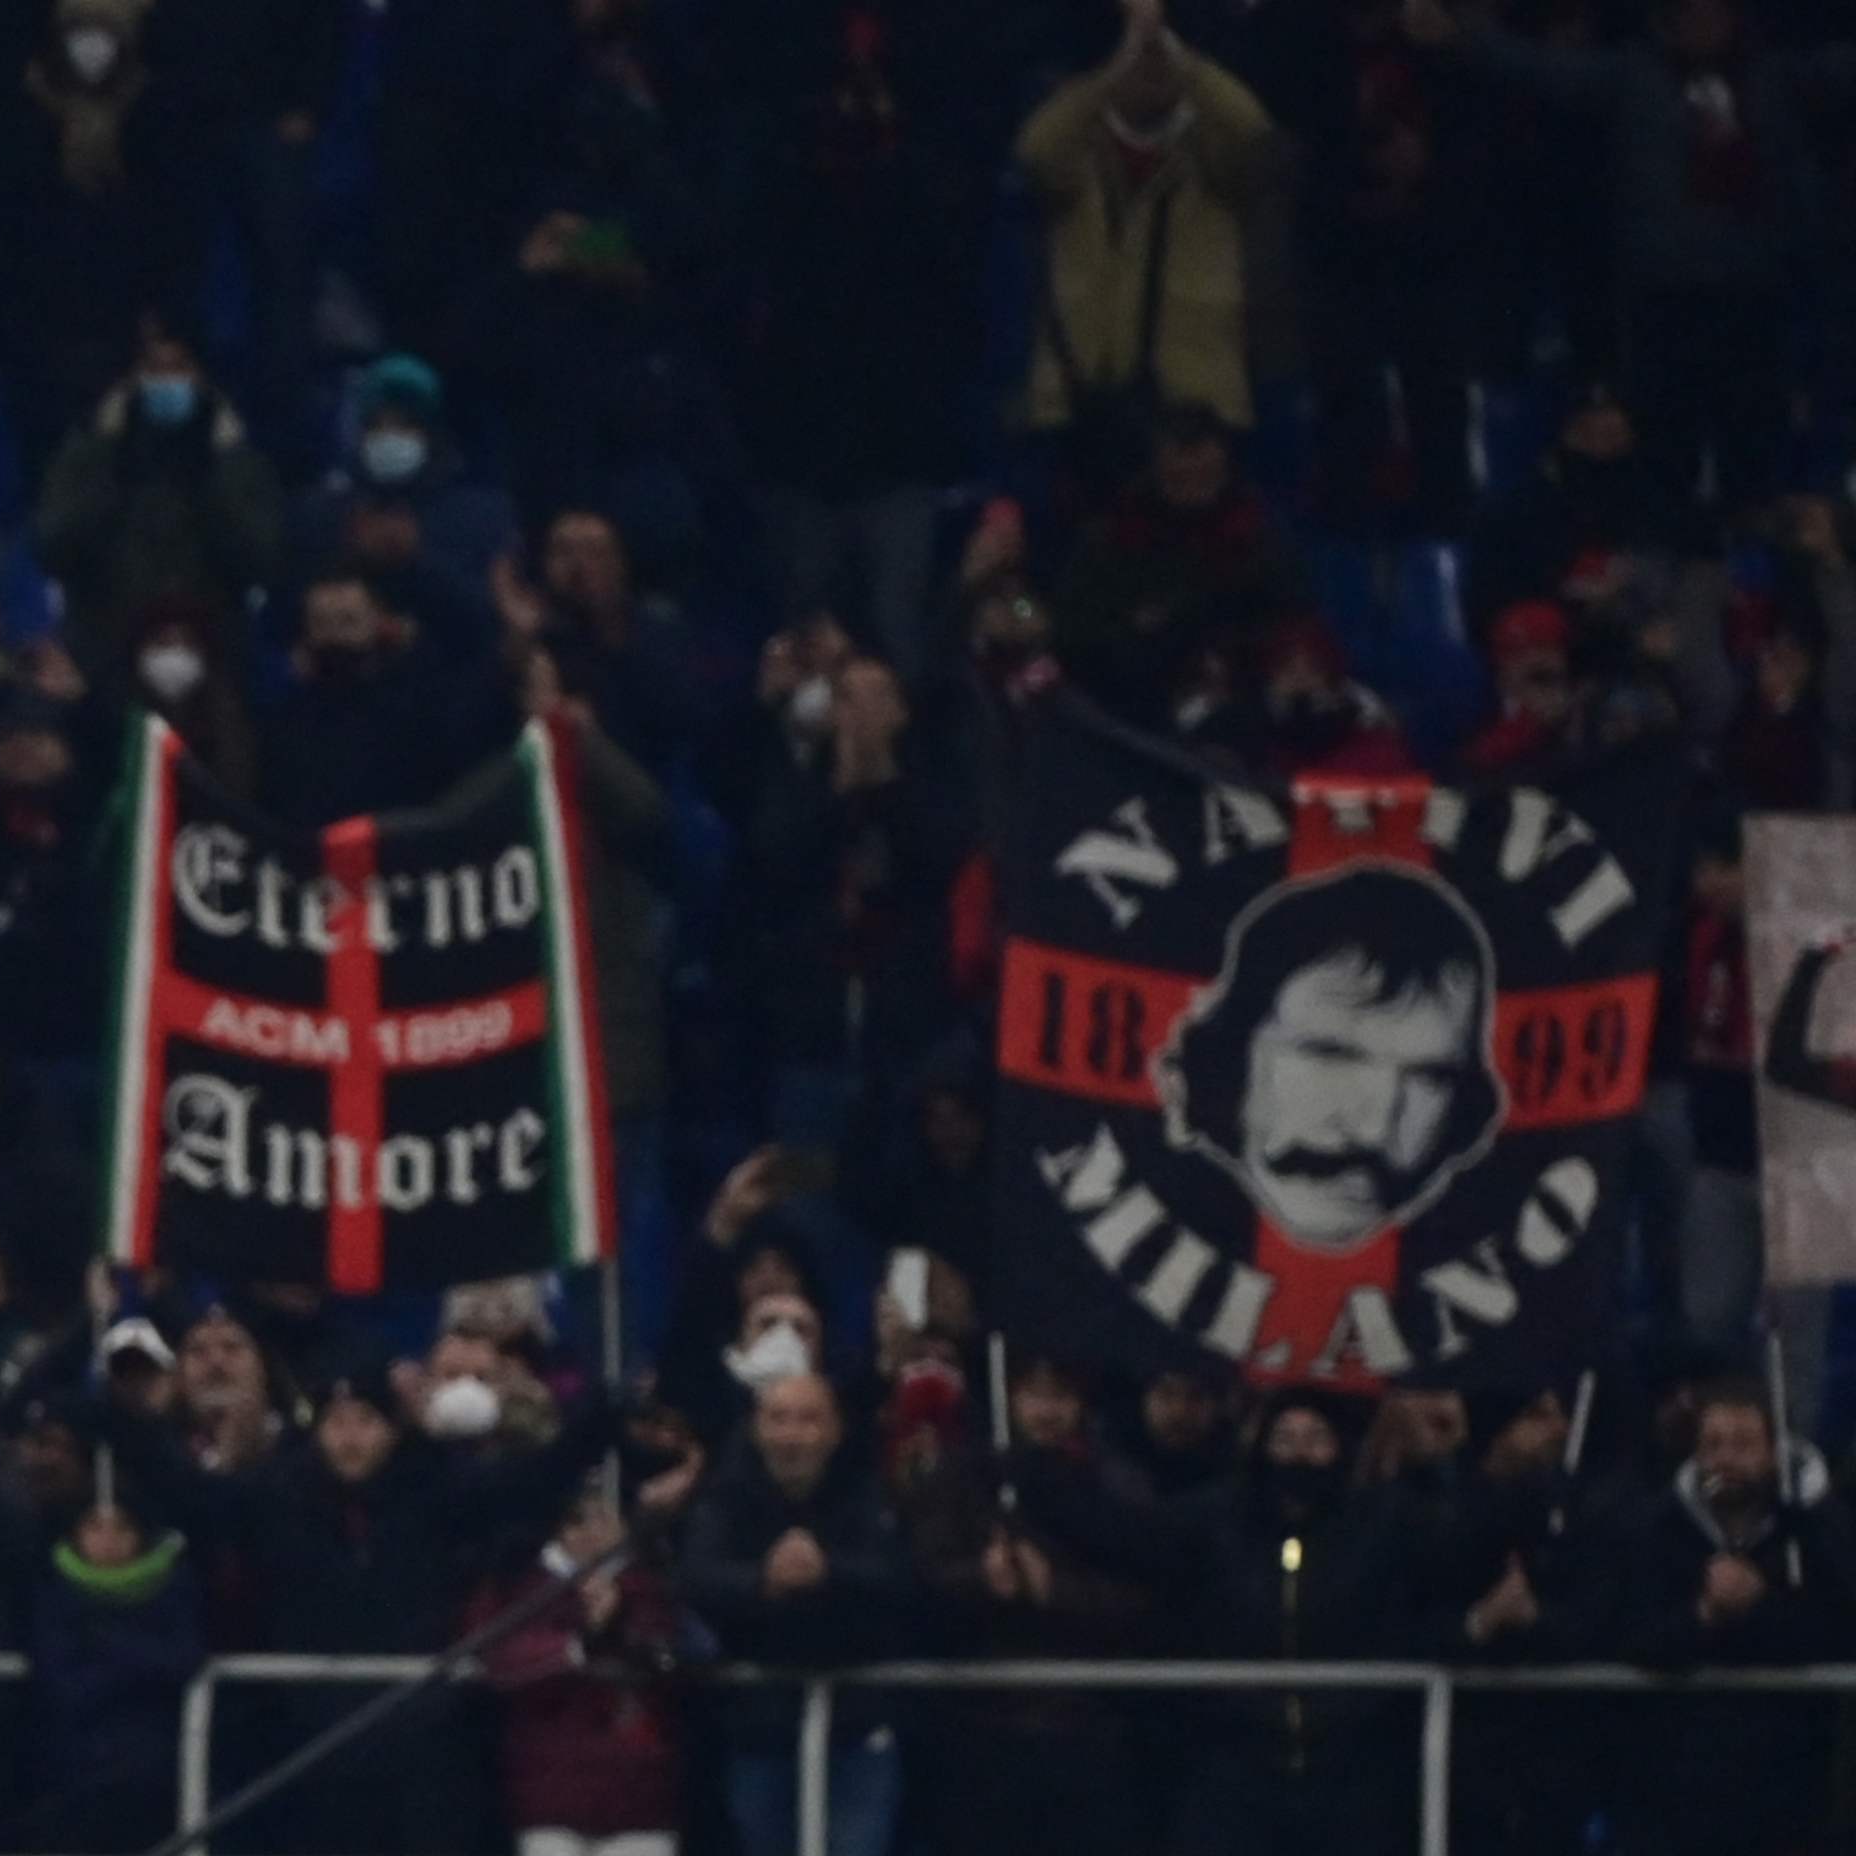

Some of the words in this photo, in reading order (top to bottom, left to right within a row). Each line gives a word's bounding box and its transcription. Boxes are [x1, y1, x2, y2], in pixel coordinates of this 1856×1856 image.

[173, 822, 542, 954] Eterno
[199, 996, 351, 1064] ACM
[165, 1074, 546, 1212] Amore
[1036, 1120, 1600, 1375] MILANO
